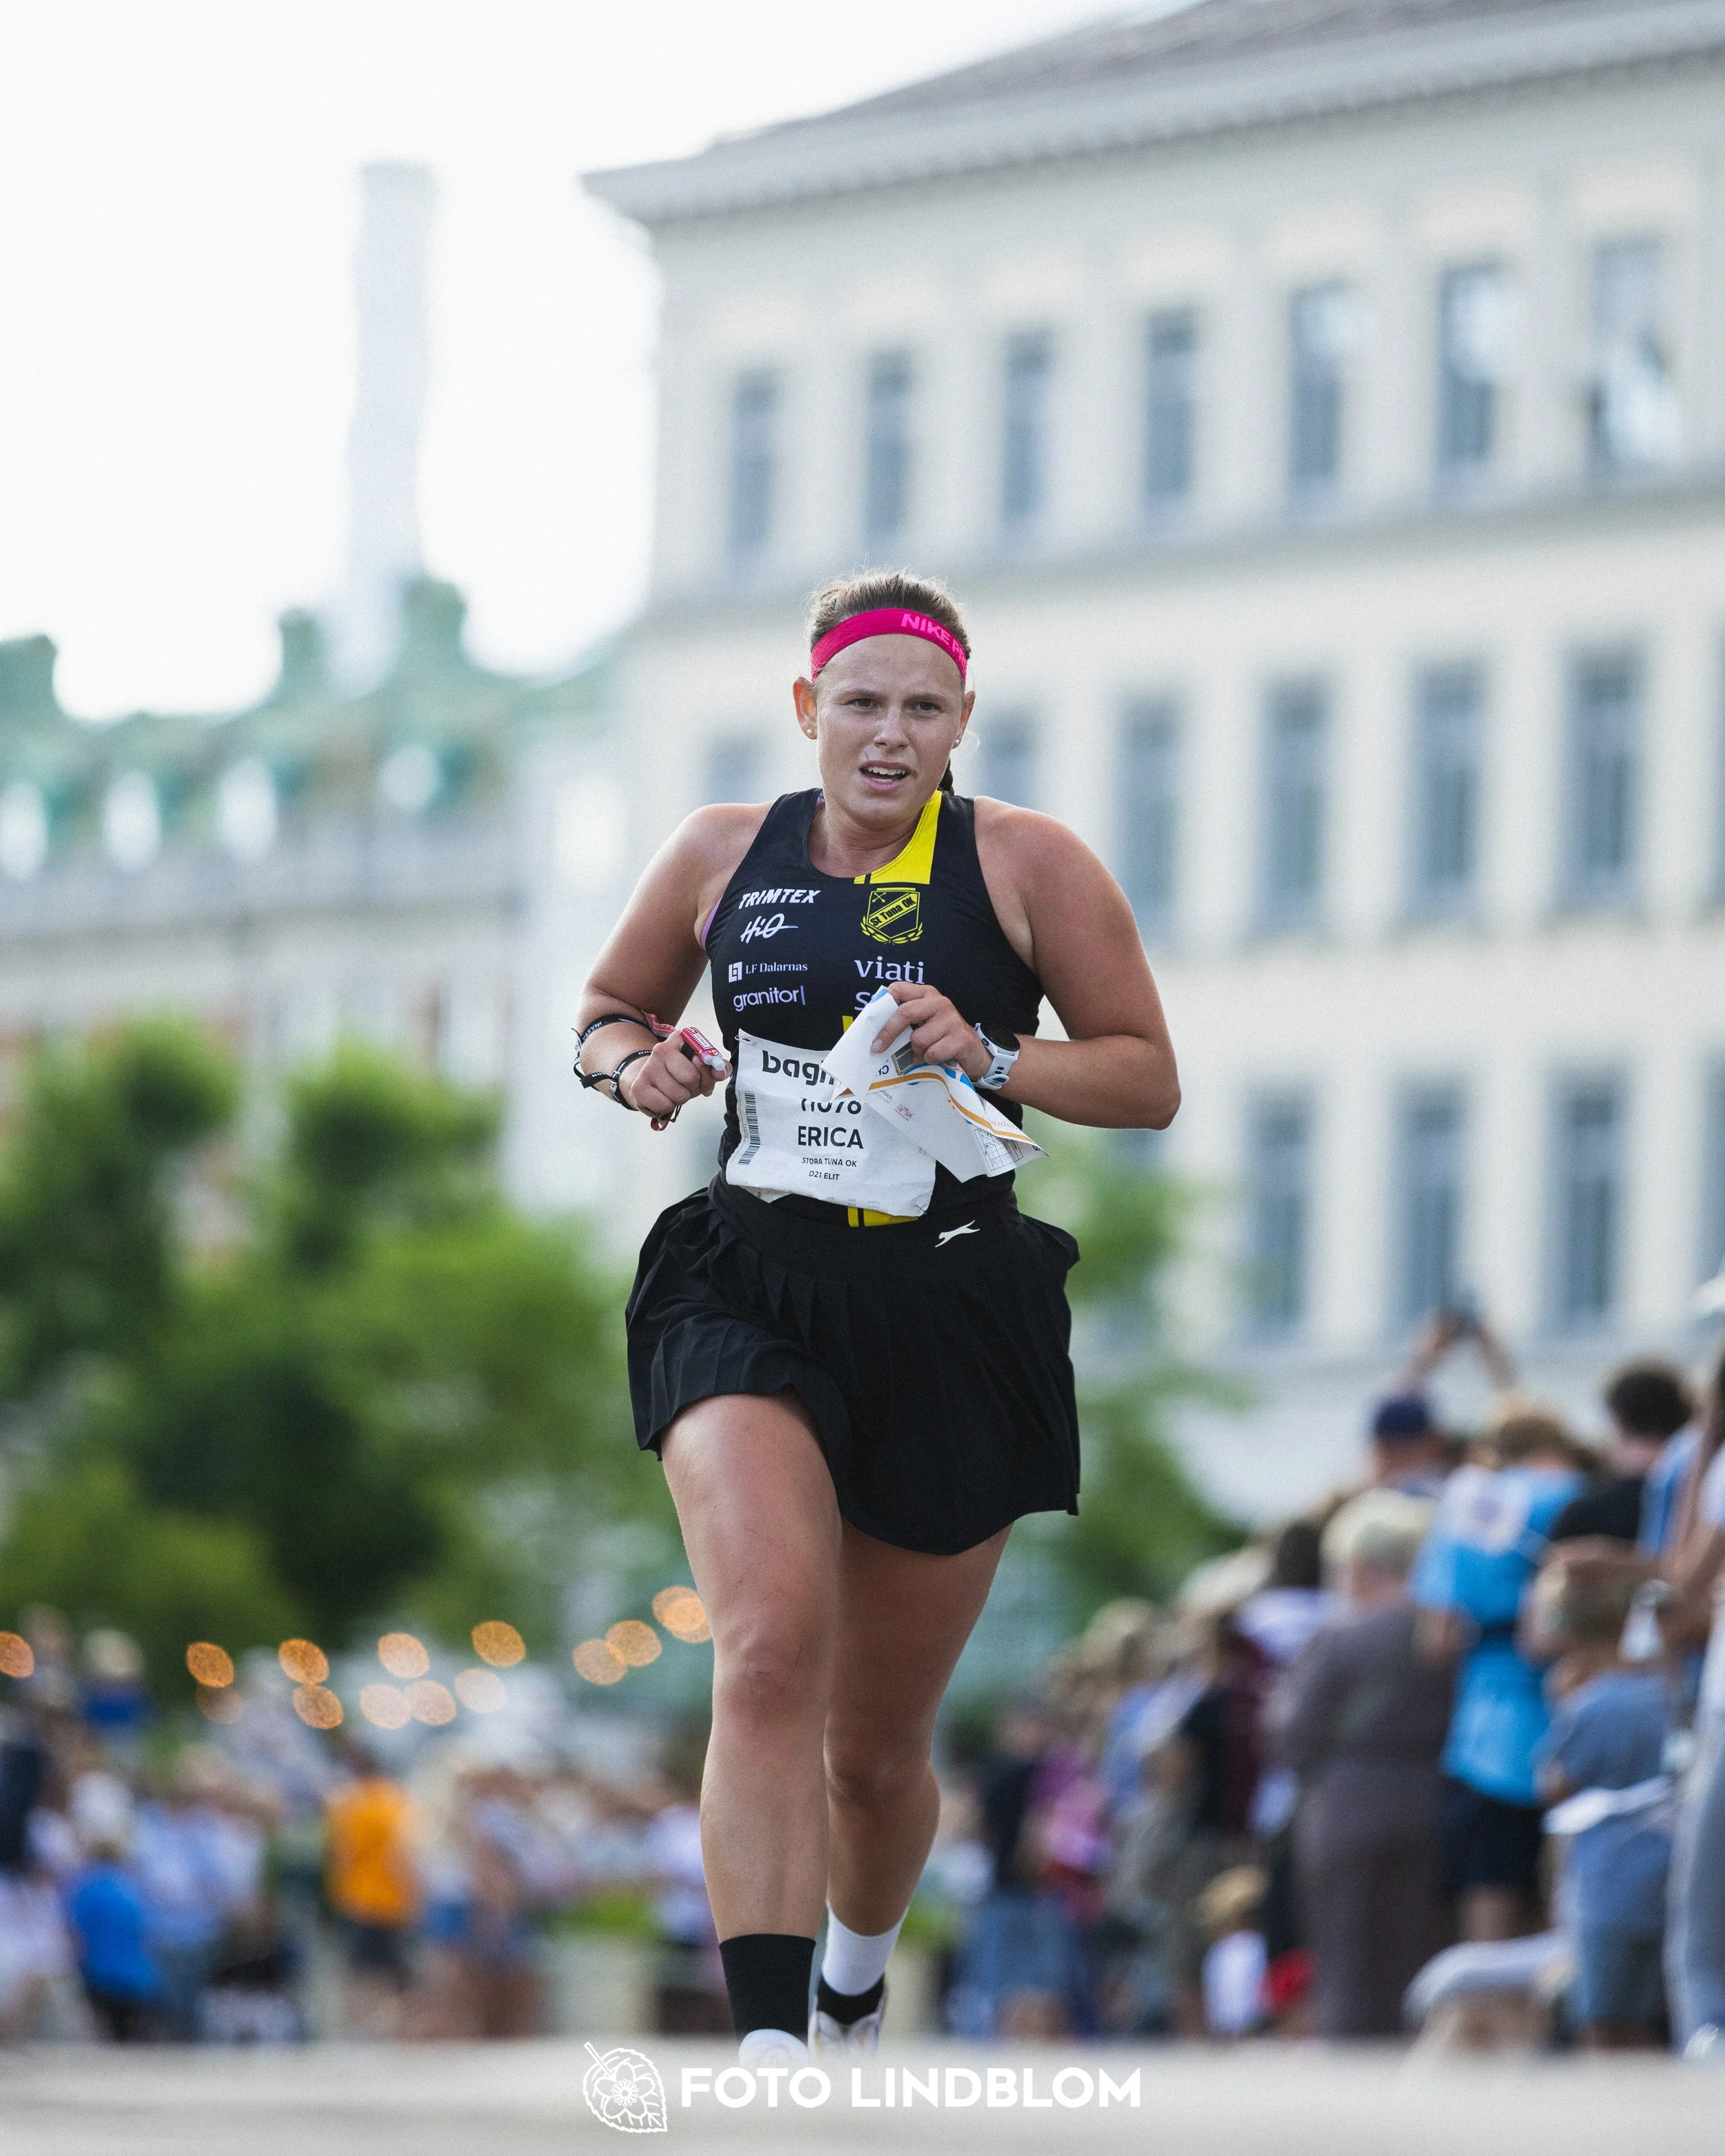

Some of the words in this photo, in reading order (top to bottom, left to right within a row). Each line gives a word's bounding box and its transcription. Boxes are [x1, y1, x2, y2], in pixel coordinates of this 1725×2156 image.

[901, 613, 950, 646] NIKE
[738, 888, 821, 909] TRIMTEX
[870, 917, 883, 927] St
[880, 904, 903, 920] Tuna
[901, 896, 916, 908] OK
[745, 964, 758, 974] LF
[760, 962, 808, 973] Dalarnas
[854, 956, 925, 985] viati
[733, 987, 799, 1012] granitor
[798, 1125, 864, 1149] ERICA
[824, 1158, 843, 1166] TUNA
[809, 1170, 822, 1178] D21
[824, 1172, 840, 1180] ELIT
